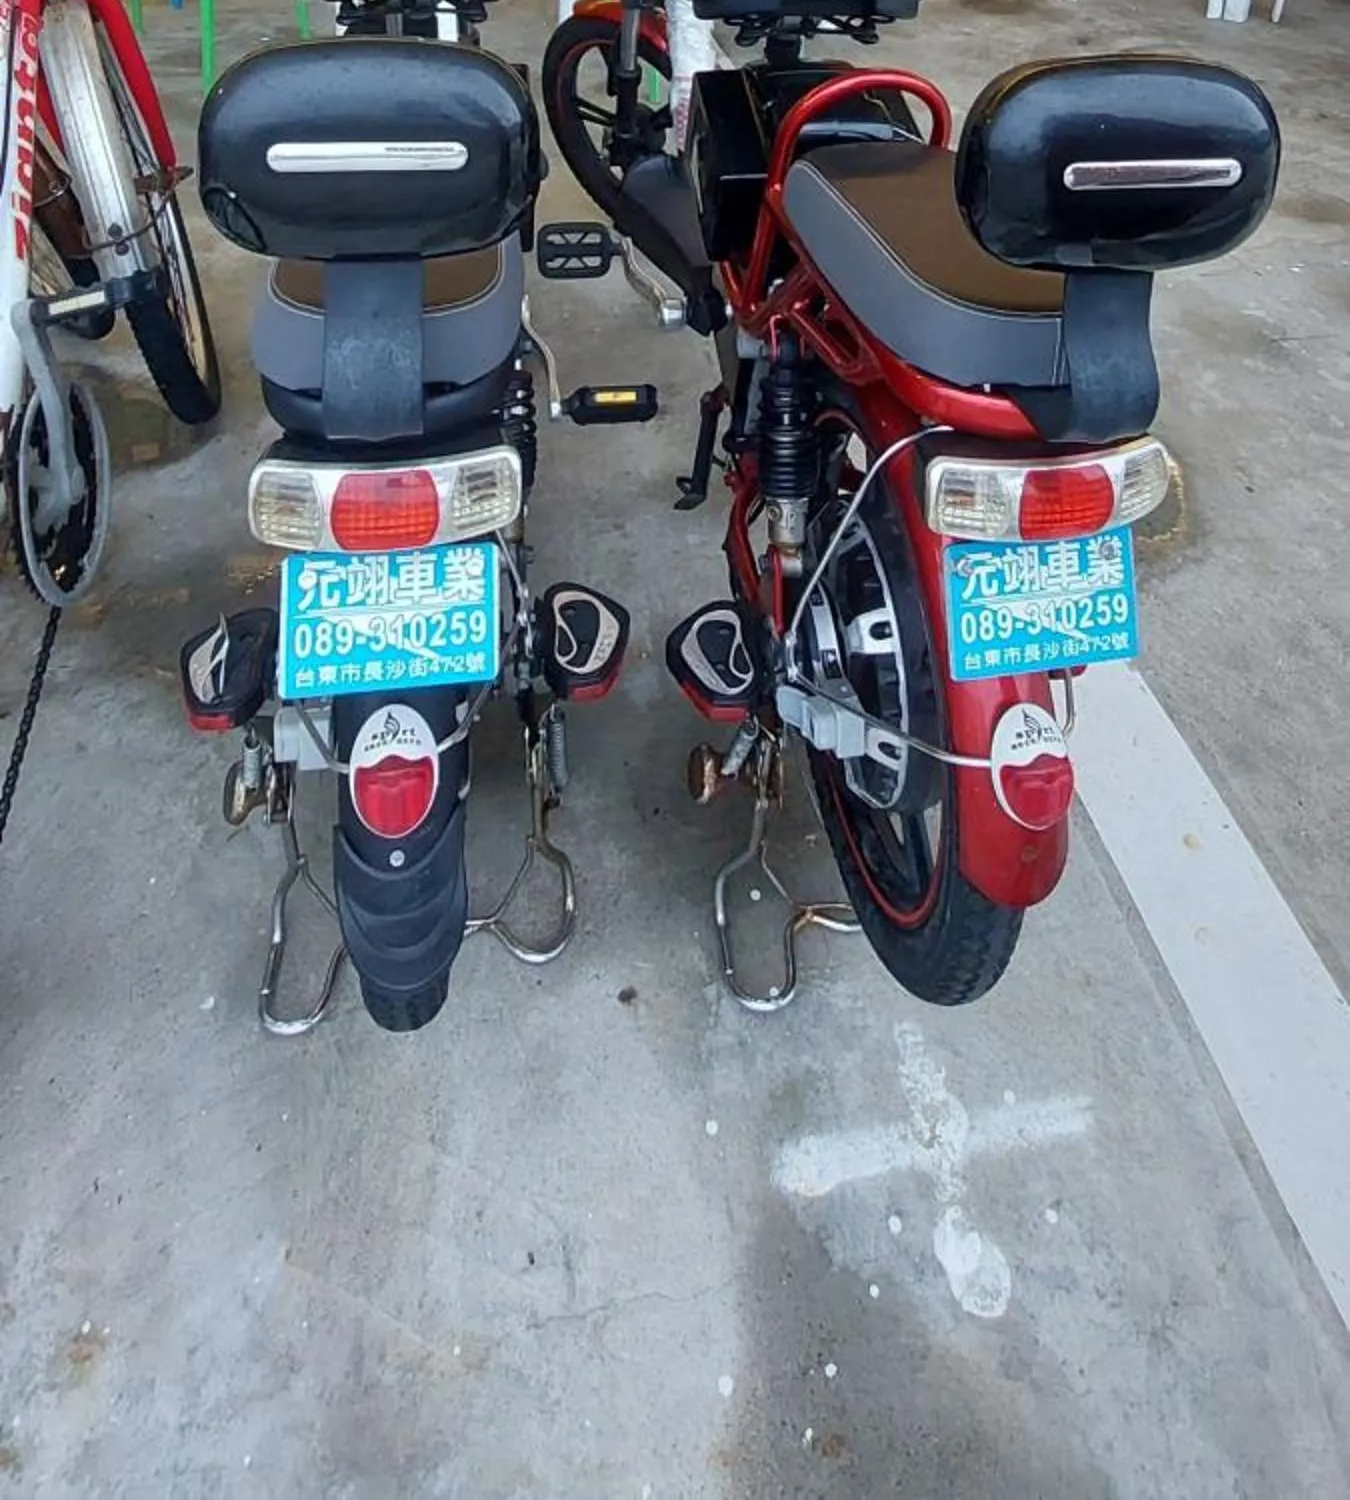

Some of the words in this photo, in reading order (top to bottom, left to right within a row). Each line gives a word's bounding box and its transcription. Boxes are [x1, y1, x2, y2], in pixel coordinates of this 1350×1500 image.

[298, 548, 486, 611] 元翊車業
[963, 535, 1124, 600] 元翊車業
[294, 609, 487, 658] 089-310259
[961, 592, 1129, 644] 089-310259
